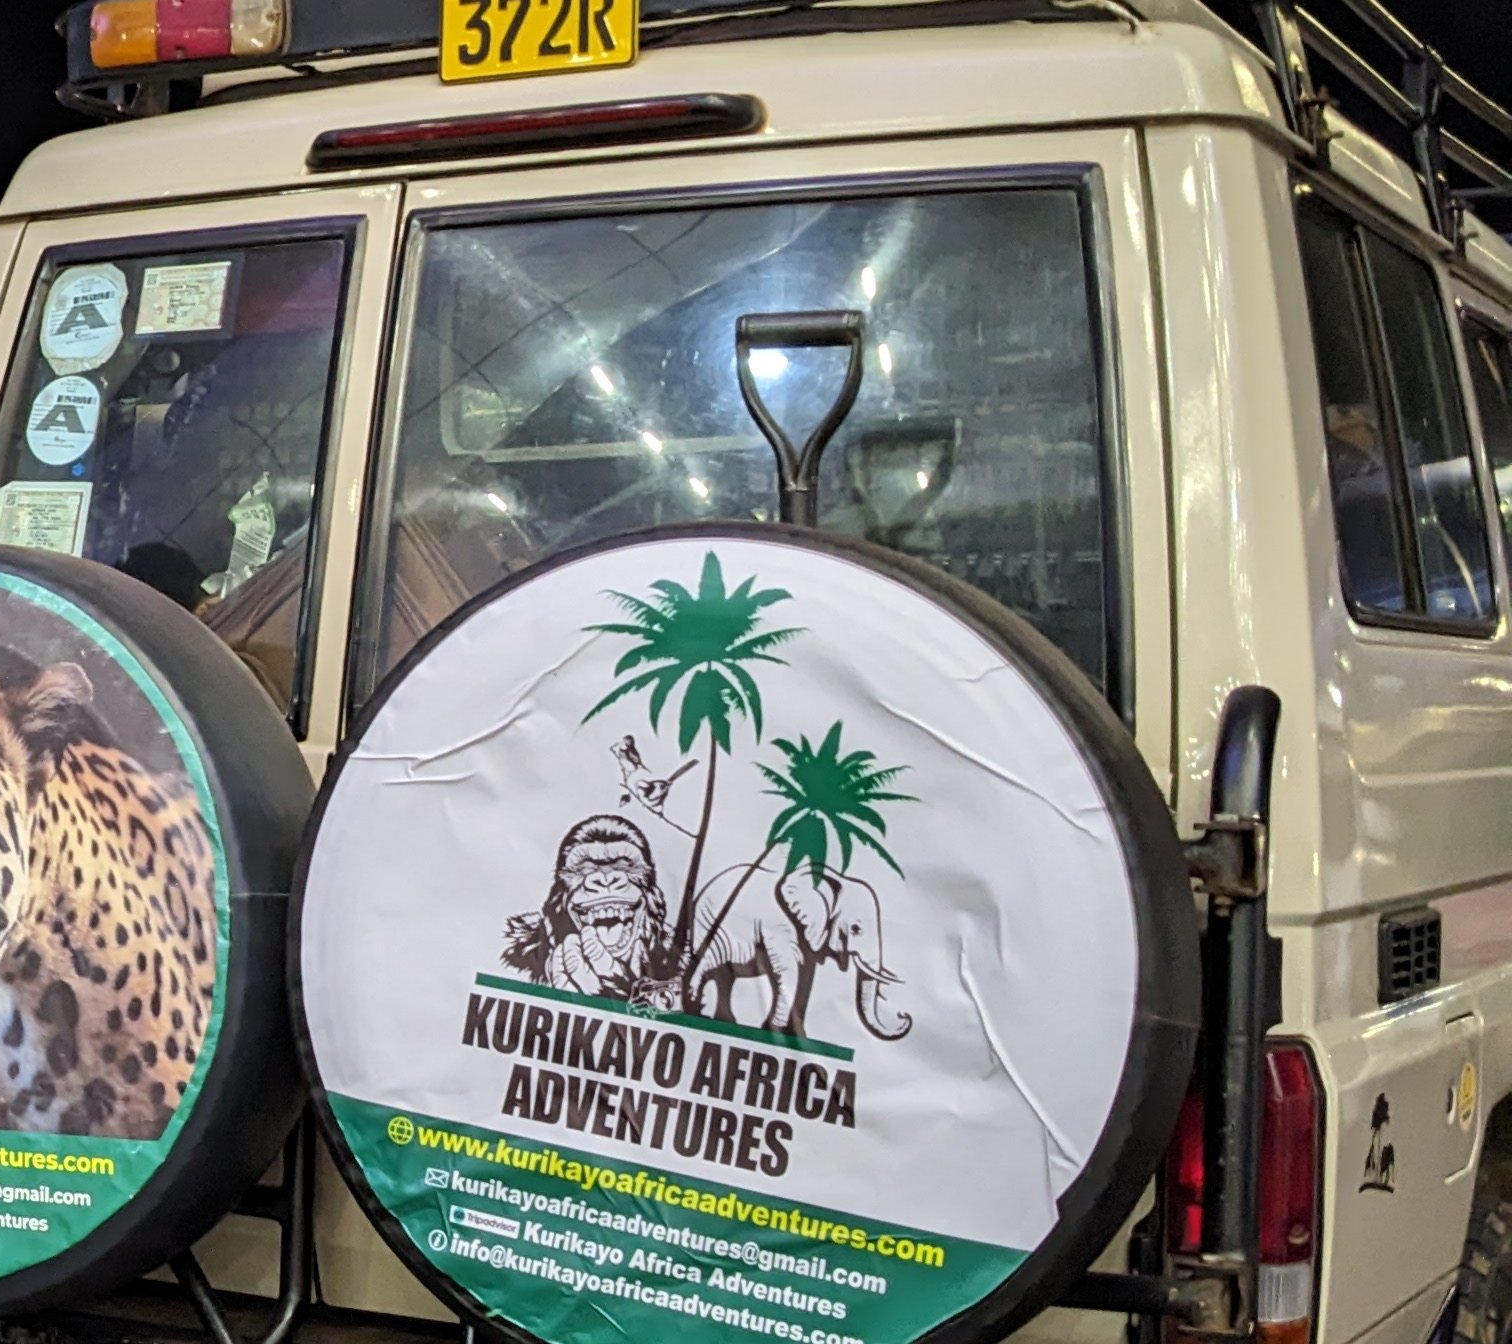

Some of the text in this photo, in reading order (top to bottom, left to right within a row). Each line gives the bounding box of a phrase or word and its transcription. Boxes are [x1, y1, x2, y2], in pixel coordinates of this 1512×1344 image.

[461, 992, 858, 1129] KURIKAYO AFRICA
[501, 1063, 794, 1177] ADVENTURES
[417, 1126, 946, 1267] www.kurikayoafricaadventures.com
[451, 1170, 888, 1295] kurikayoafricaadventures@gmail.com
[466, 1212, 847, 1320] Tripadvisor Kurikayo Africa Adventures
